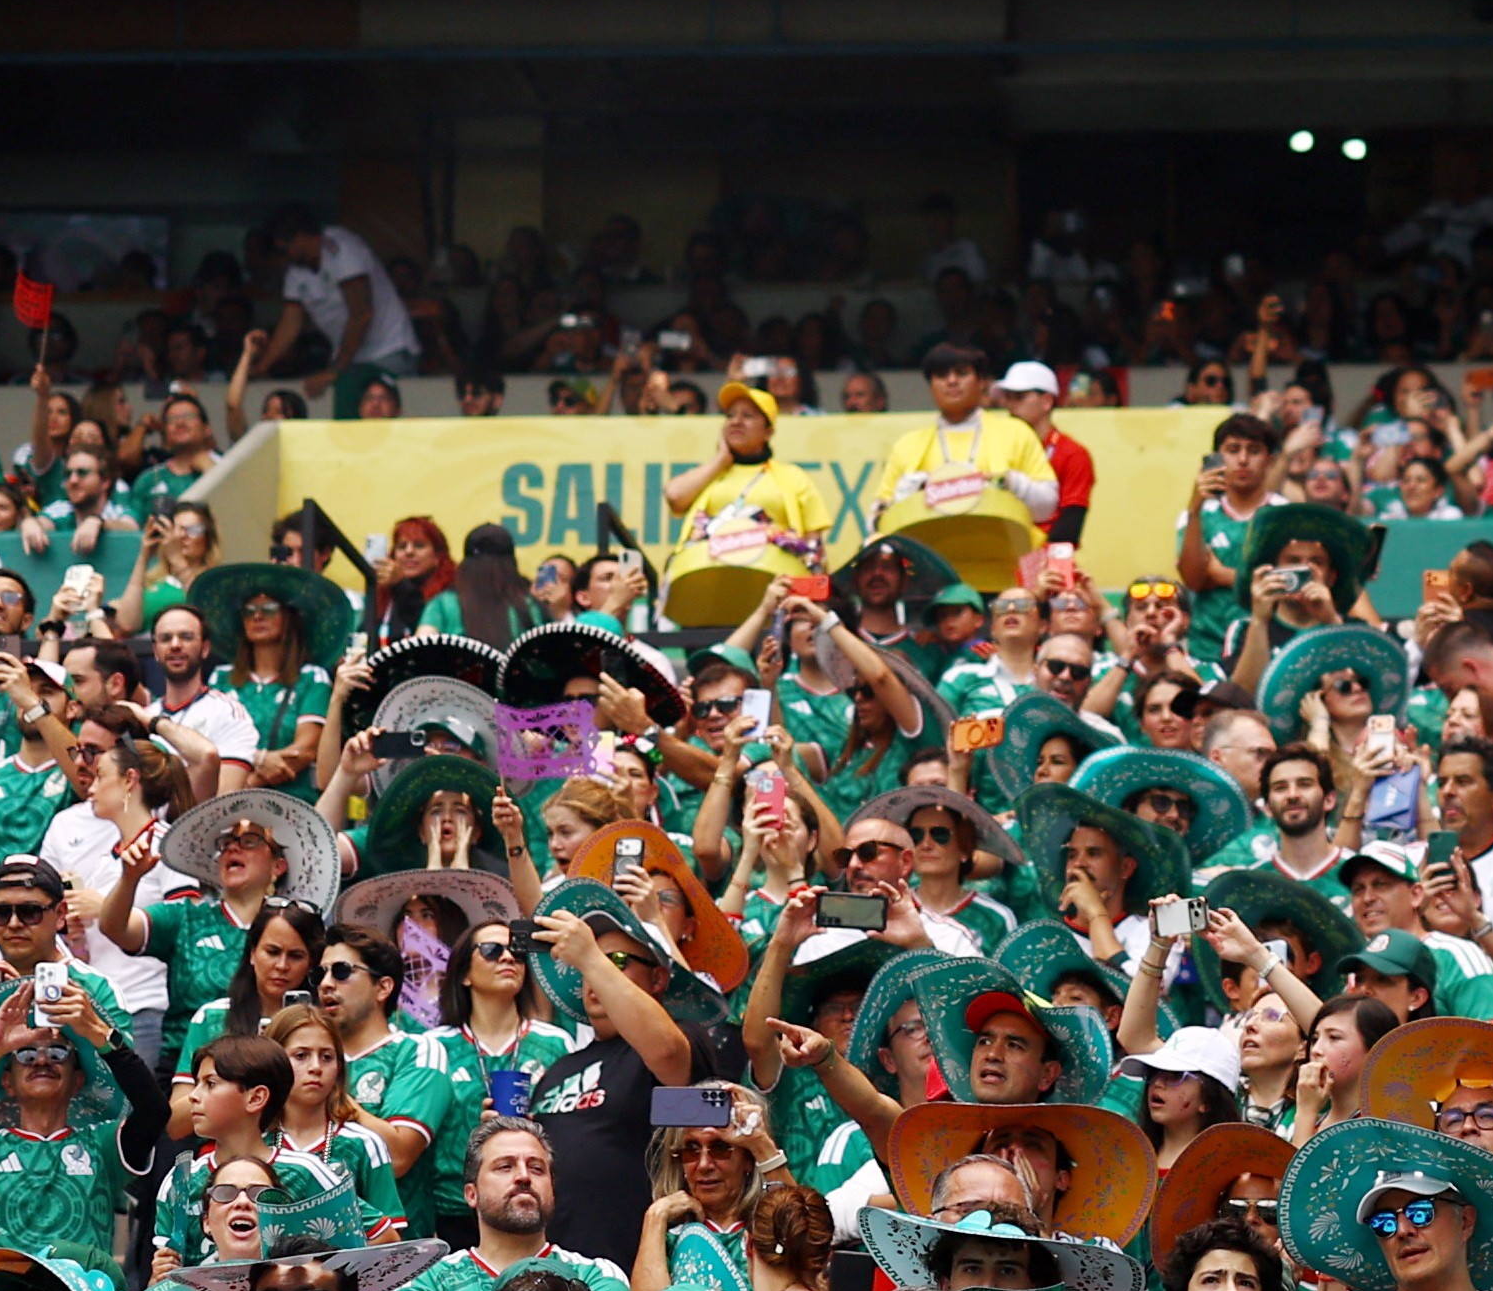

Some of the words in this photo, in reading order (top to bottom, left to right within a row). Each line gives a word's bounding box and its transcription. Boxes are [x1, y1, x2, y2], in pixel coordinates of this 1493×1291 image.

[534, 1089, 606, 1115] adidas
[1320, 1126, 1344, 1142] FIFA
[1287, 1166, 1302, 1190] FIFA
[309, 1191, 334, 1208] FIFA
